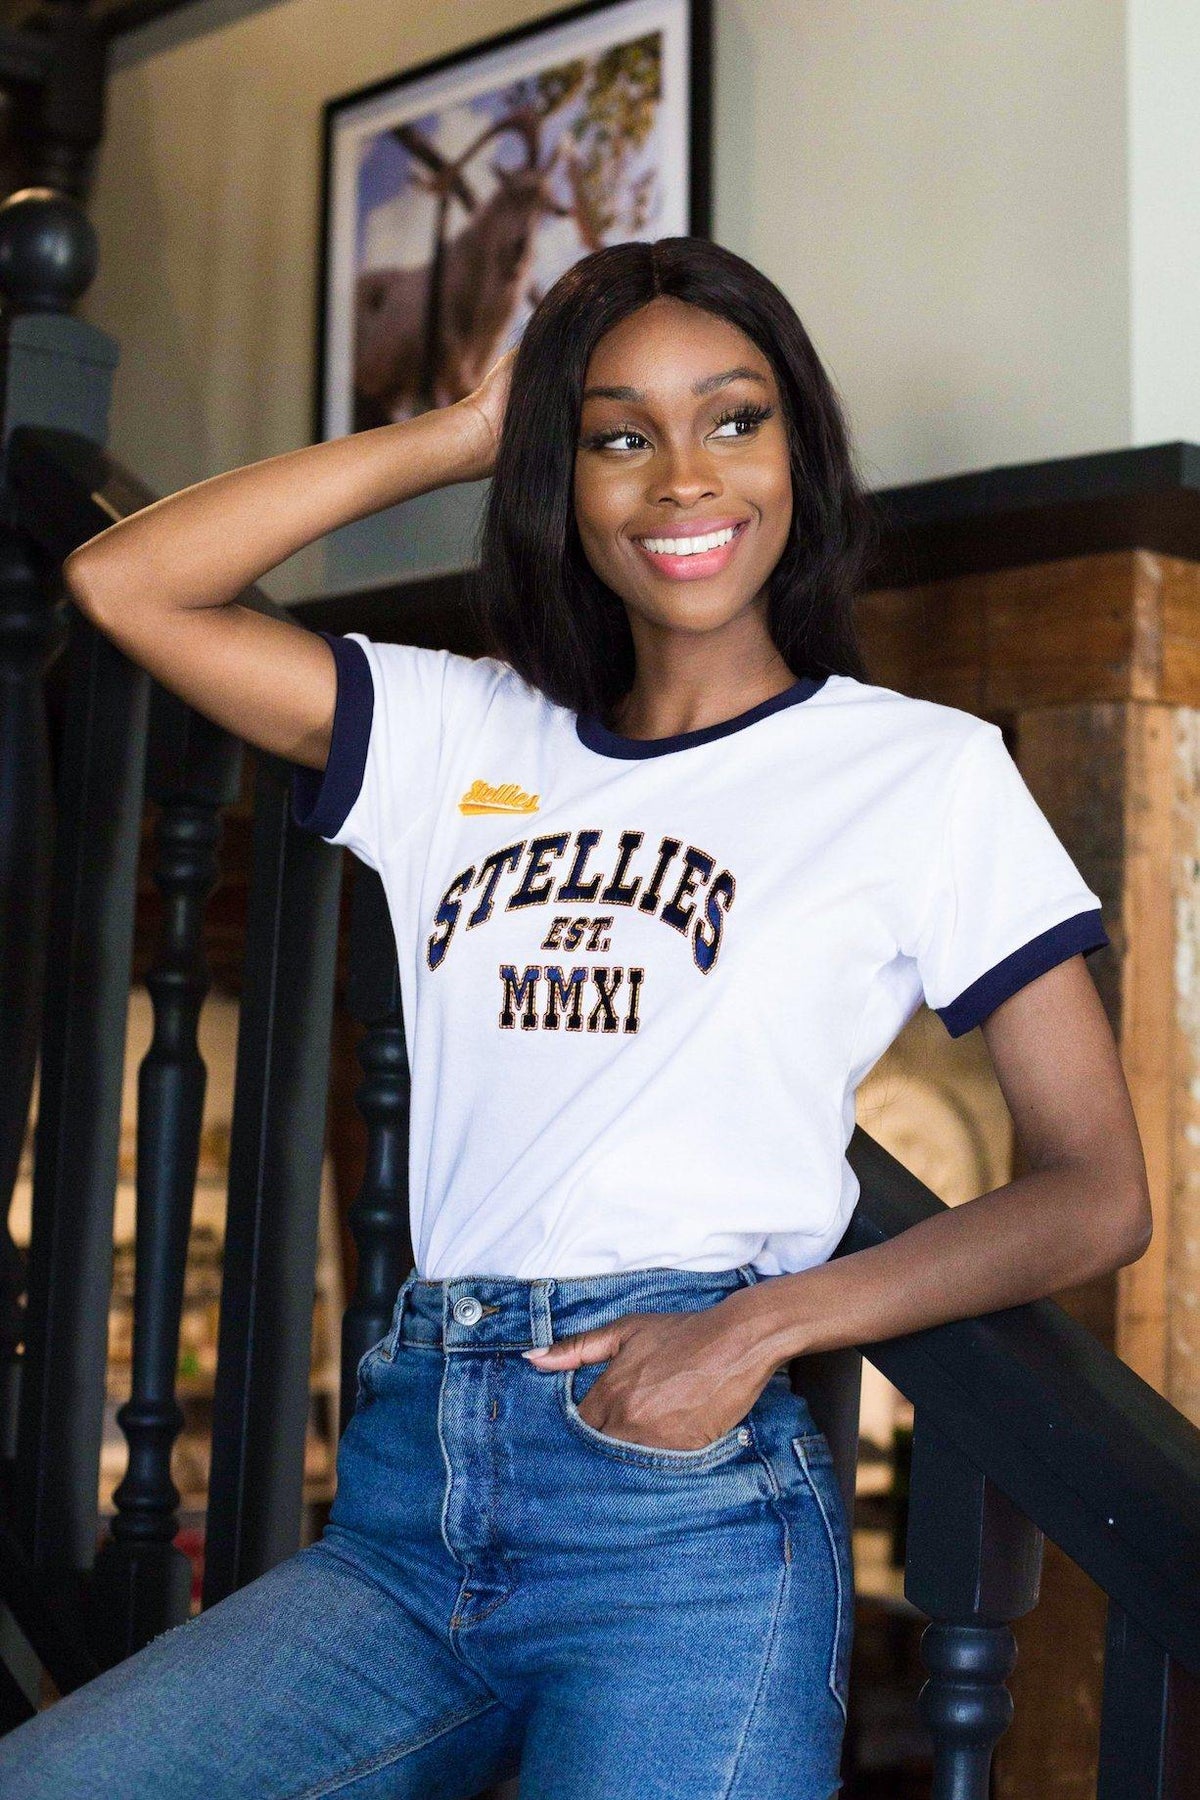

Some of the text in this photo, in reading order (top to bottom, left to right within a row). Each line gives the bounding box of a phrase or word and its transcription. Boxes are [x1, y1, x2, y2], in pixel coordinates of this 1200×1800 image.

[461, 779, 540, 810] Stellies
[426, 829, 737, 976] STELLIES
[540, 916, 614, 952] EST.
[498, 964, 645, 1035] MMXI
